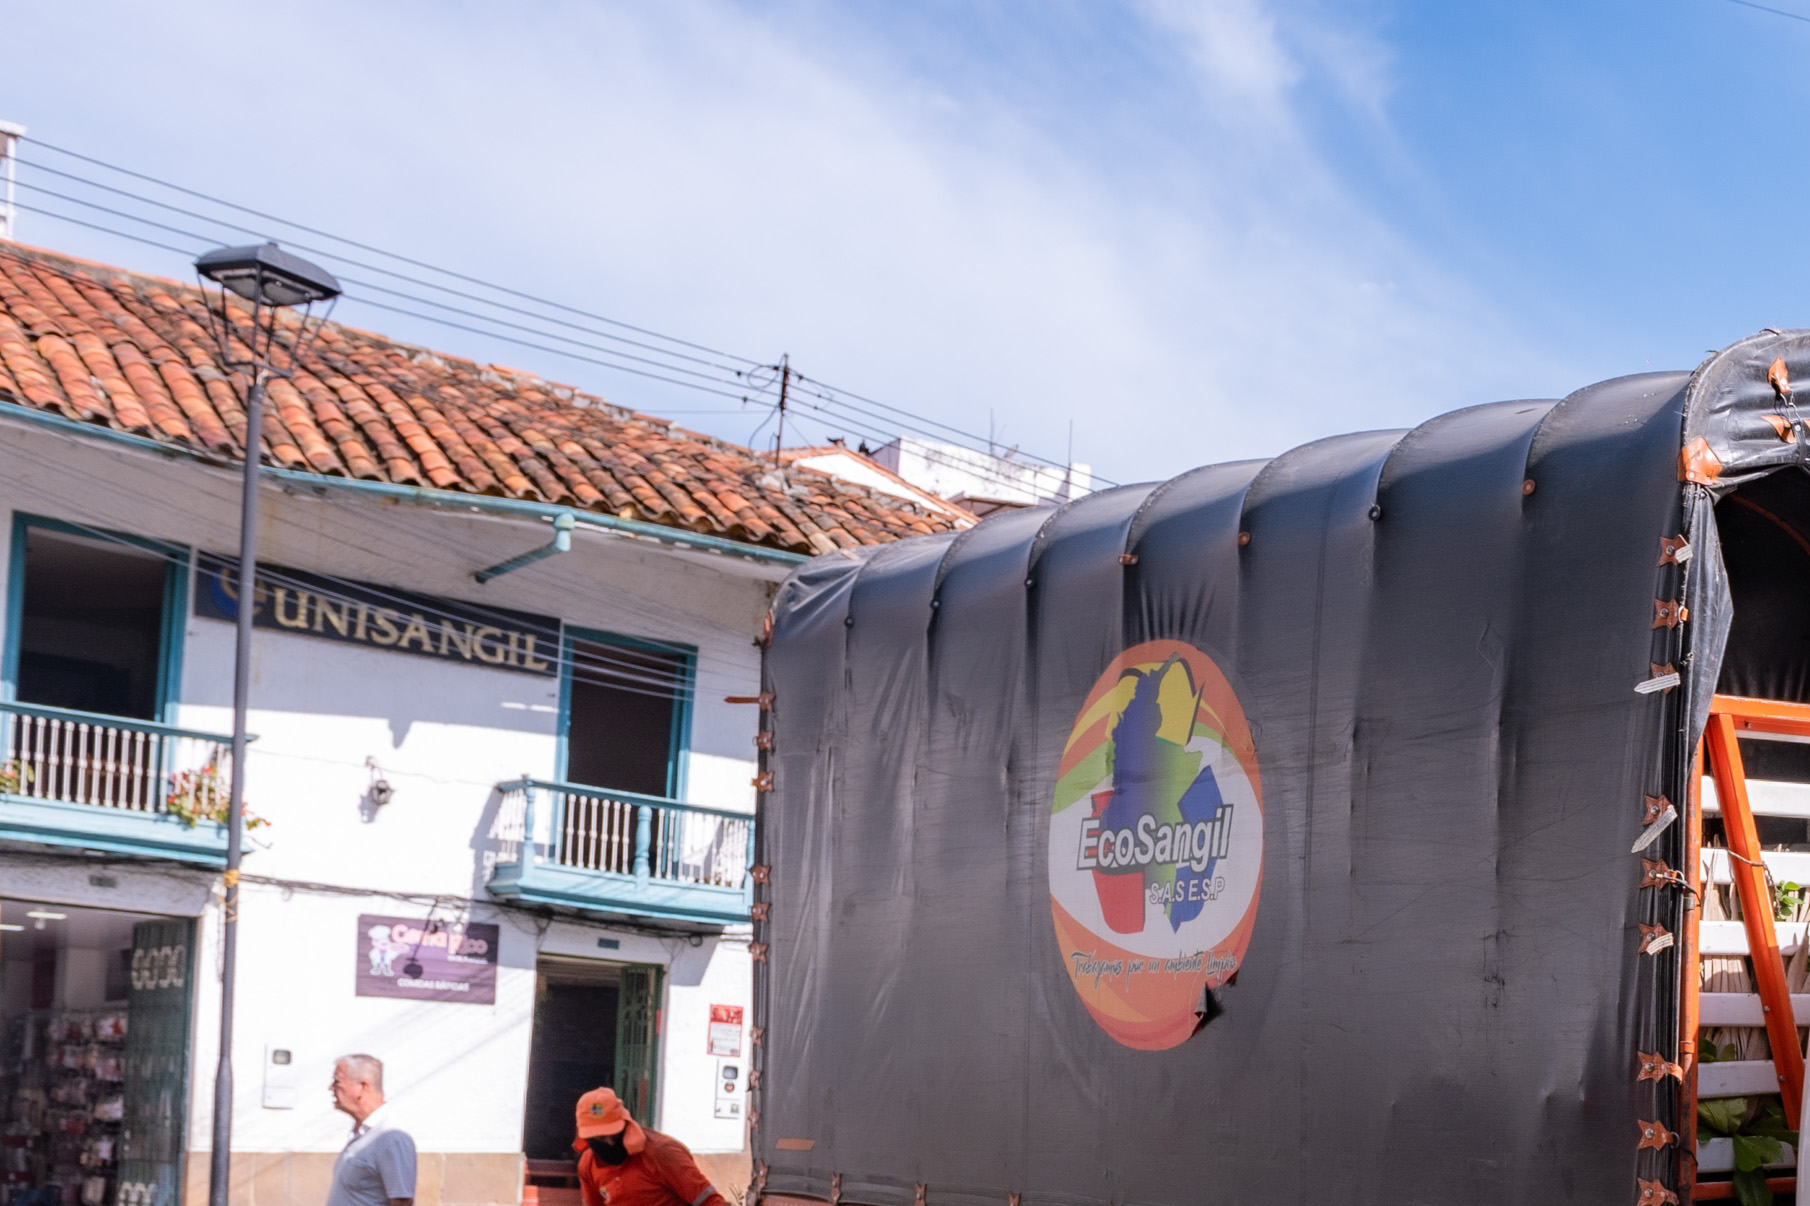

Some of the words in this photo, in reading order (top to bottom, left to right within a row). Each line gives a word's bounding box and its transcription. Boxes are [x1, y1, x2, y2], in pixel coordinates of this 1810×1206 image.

[272, 586, 549, 671] UNISANGIL
[1077, 804, 1234, 874] EcoSangil
[1150, 881, 1185, 904] S.A.S
[1188, 877, 1225, 901] E.S.P
[1125, 959, 1144, 993] por
